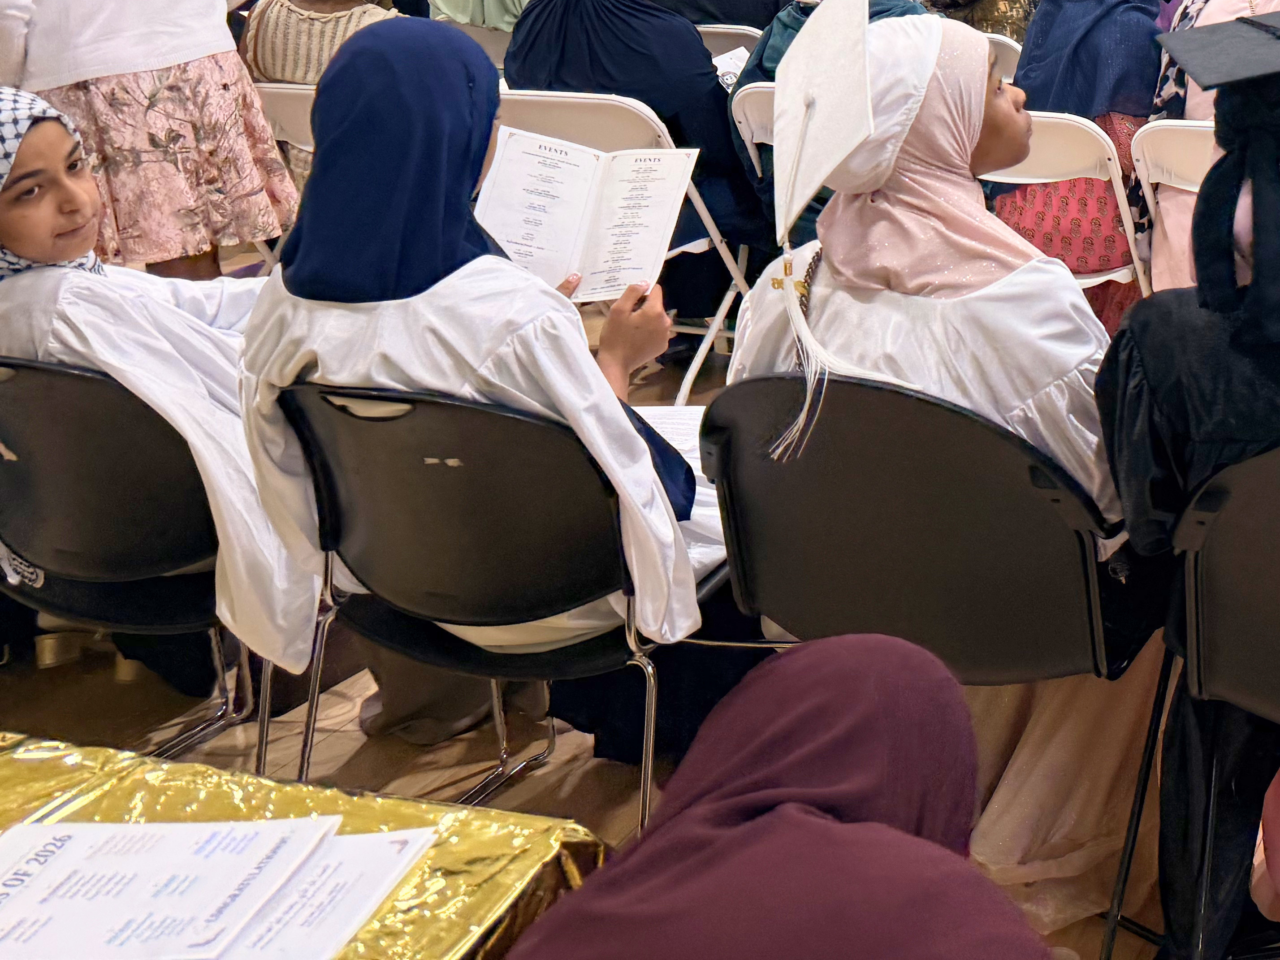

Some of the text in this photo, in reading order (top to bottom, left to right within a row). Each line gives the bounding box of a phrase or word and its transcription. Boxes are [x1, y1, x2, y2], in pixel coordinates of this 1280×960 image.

[538, 144, 569, 157] EVENTS
[2, 868, 33, 888] OF
[26, 834, 73, 866] 2026
